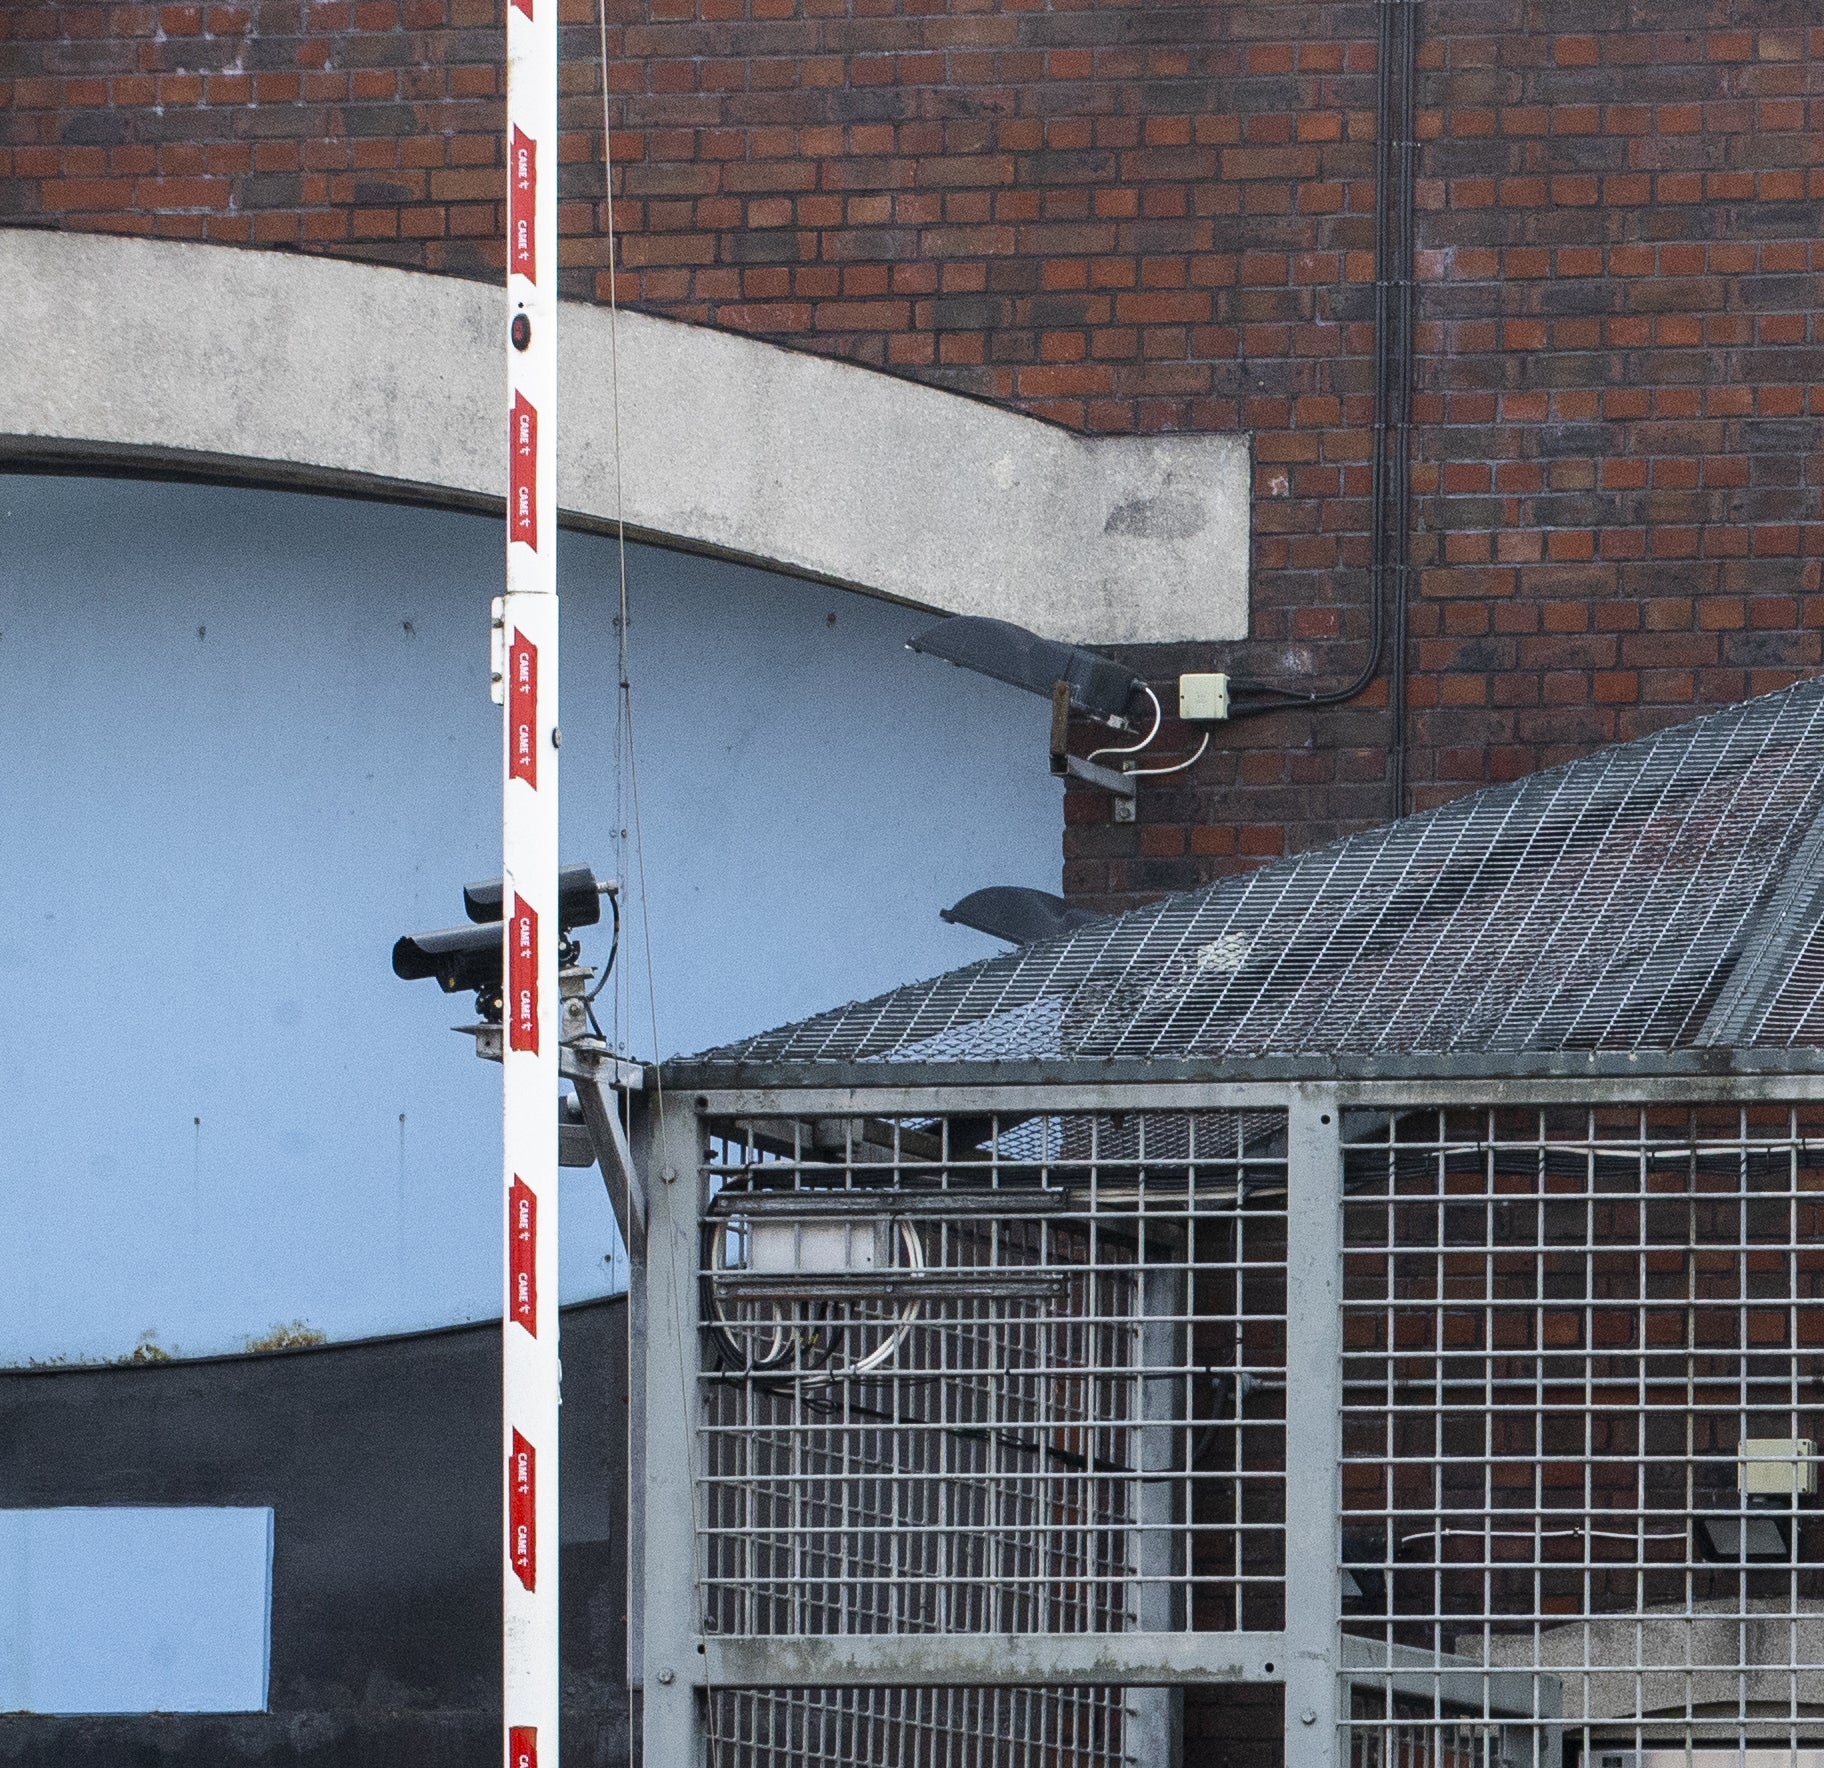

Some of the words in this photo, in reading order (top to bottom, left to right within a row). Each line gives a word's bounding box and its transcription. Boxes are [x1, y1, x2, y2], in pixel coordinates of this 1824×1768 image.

[517, 148, 528, 178] CAME
[517, 219, 528, 249] CAME
[519, 414, 530, 444] CAME
[518, 486, 529, 516] CAME
[519, 652, 530, 682] CAME
[518, 724, 529, 754] CAME
[519, 917, 530, 947] CAME
[520, 989, 531, 1019] CAME
[518, 1199, 529, 1229] CAME
[518, 1272, 529, 1302] CAME
[517, 1452, 528, 1482] CAME
[517, 1525, 528, 1555] CAME
